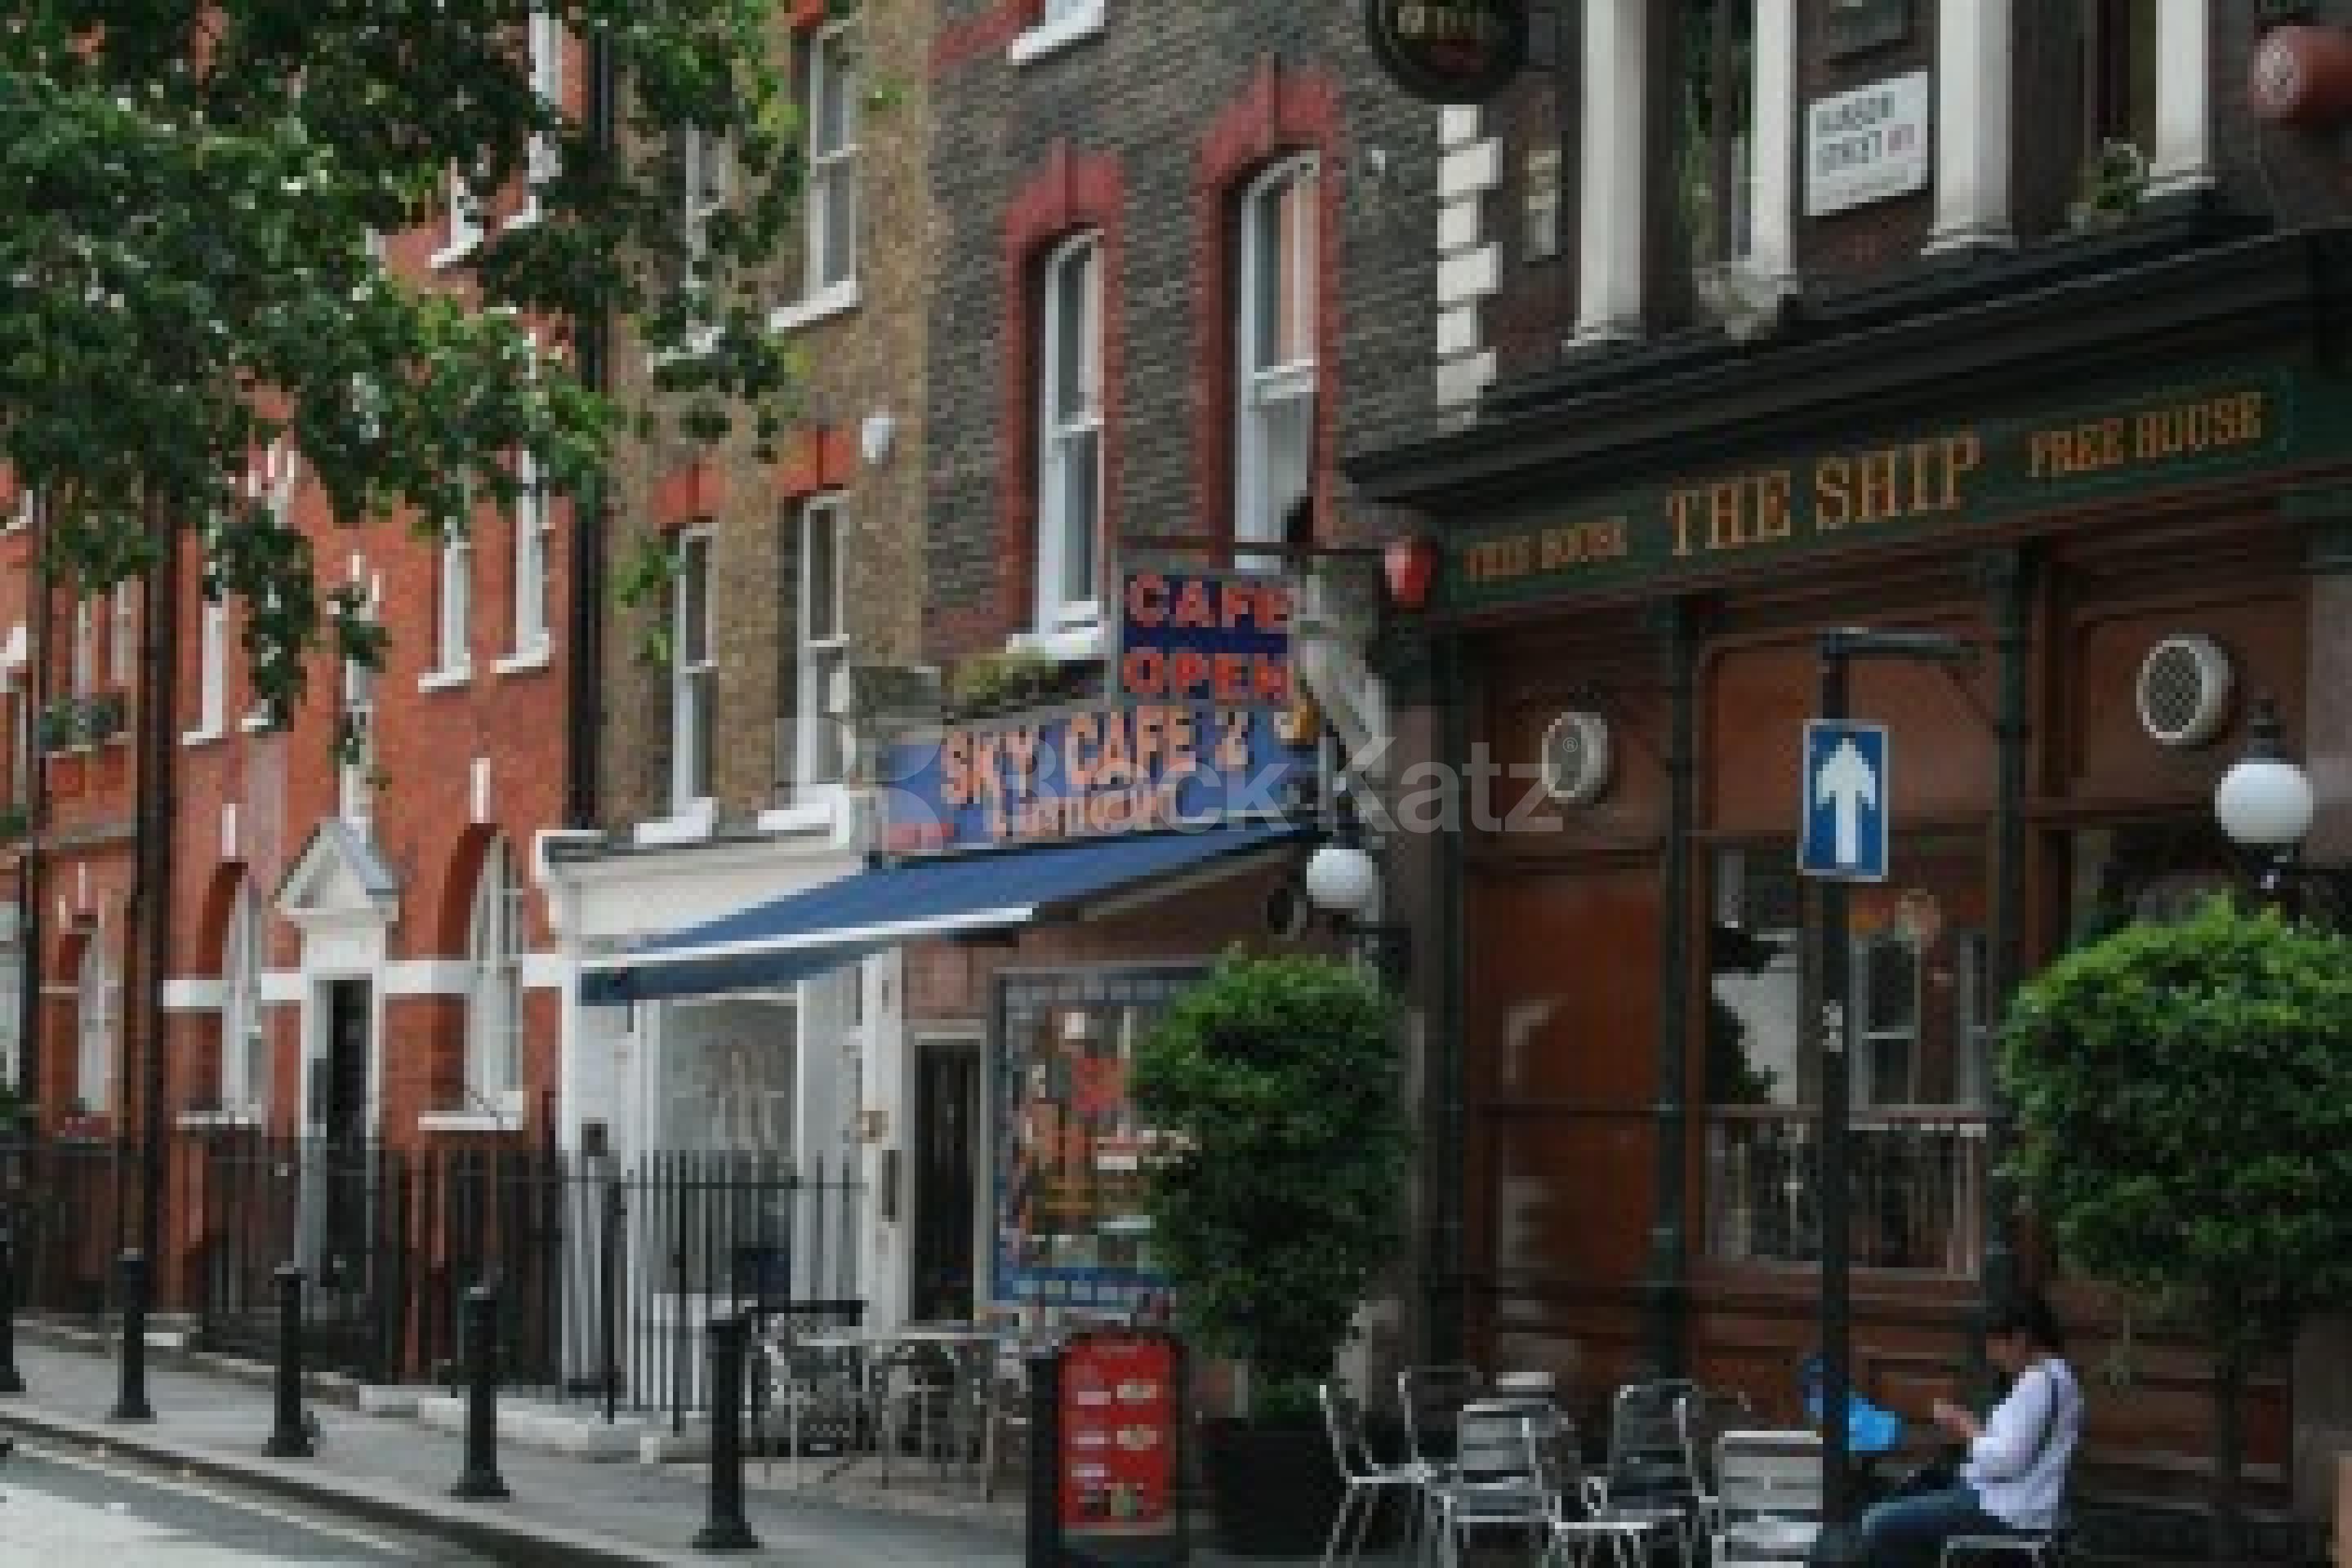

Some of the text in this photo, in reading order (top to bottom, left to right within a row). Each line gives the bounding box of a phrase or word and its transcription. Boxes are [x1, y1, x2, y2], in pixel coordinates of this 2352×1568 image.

[2027, 392, 2262, 479] FREE HOUSE
[1665, 430, 1983, 559] THE SHIP
[1127, 570, 1291, 630] CAFE
[1122, 650, 1291, 702] OPEN
[941, 728, 1039, 807] SKY
[1064, 704, 1198, 791] CAFE
